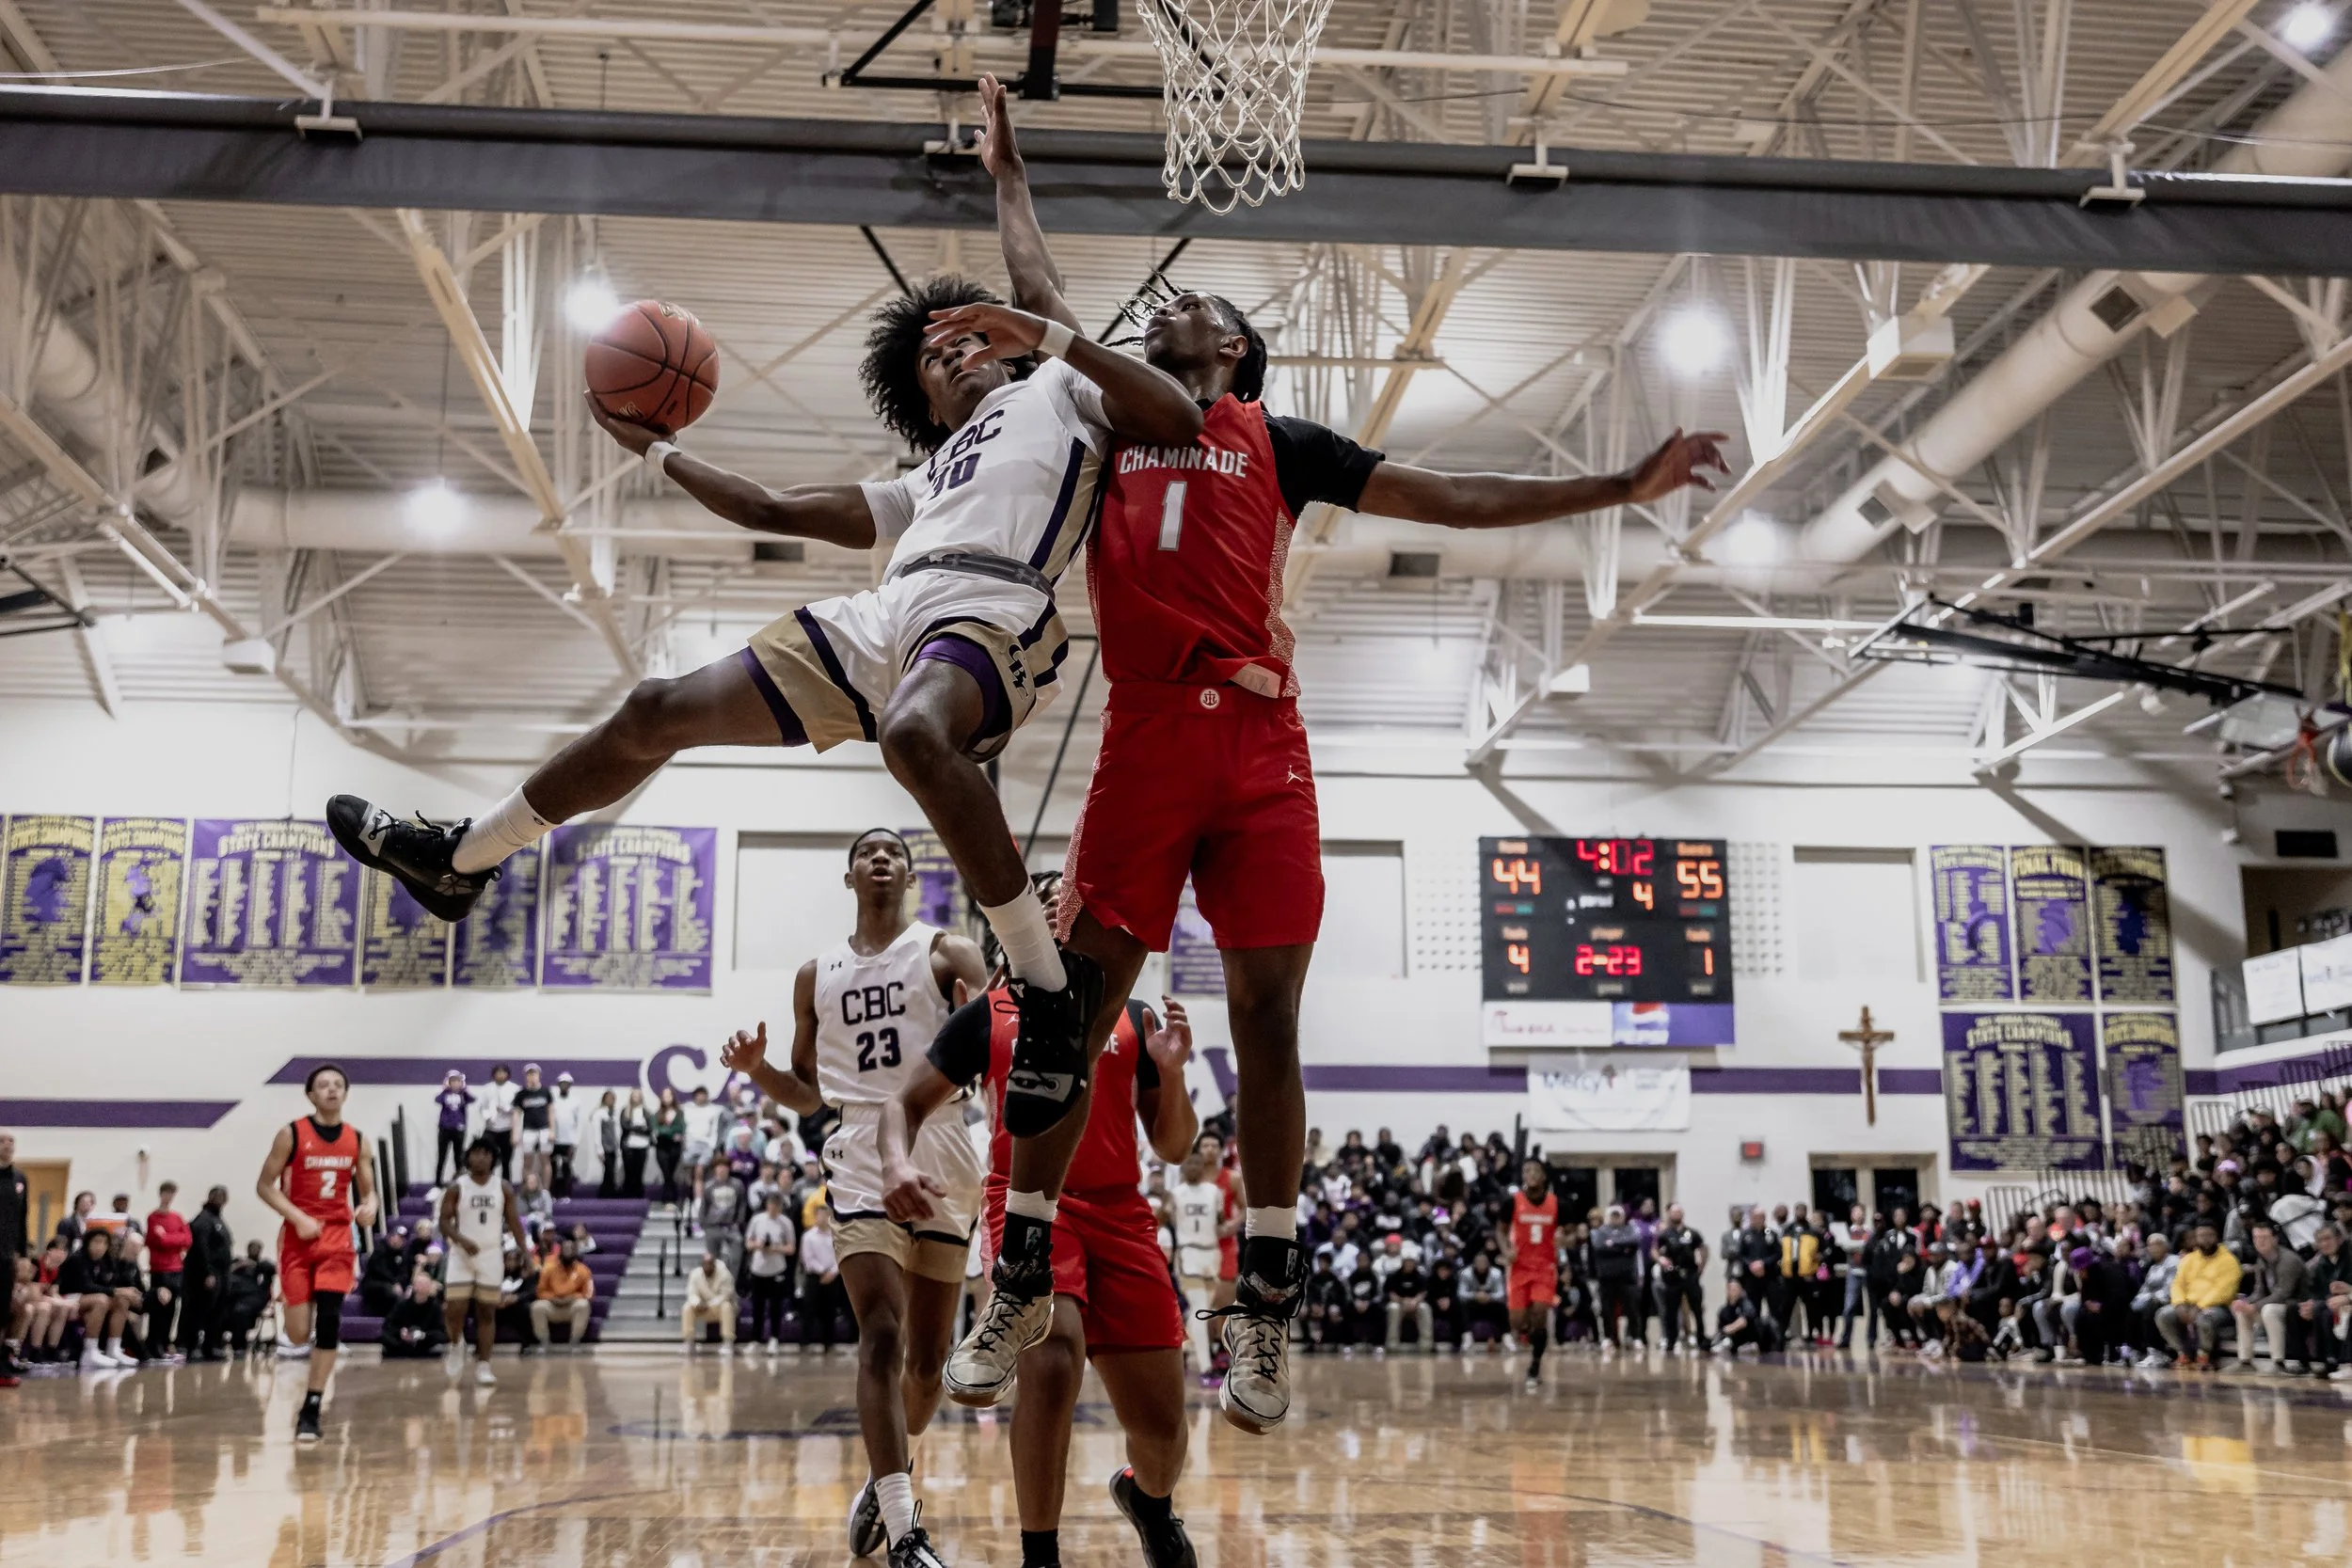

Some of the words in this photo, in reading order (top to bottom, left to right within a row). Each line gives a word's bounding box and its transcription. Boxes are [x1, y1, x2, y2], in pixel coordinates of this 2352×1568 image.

[1119, 445, 1249, 479] CHAMINADE
[1157, 480, 1188, 552] 1
[1576, 839, 1655, 876] 4:02
[1492, 858, 1542, 895] 44
[1676, 859, 1724, 899] 55
[1632, 880, 1654, 911] 4
[1507, 943, 1530, 974] 4
[1704, 947, 1714, 975] 1
[841, 981, 907, 1026] CBC
[856, 1026, 902, 1073] 23
[319, 1170, 338, 1199] 2
